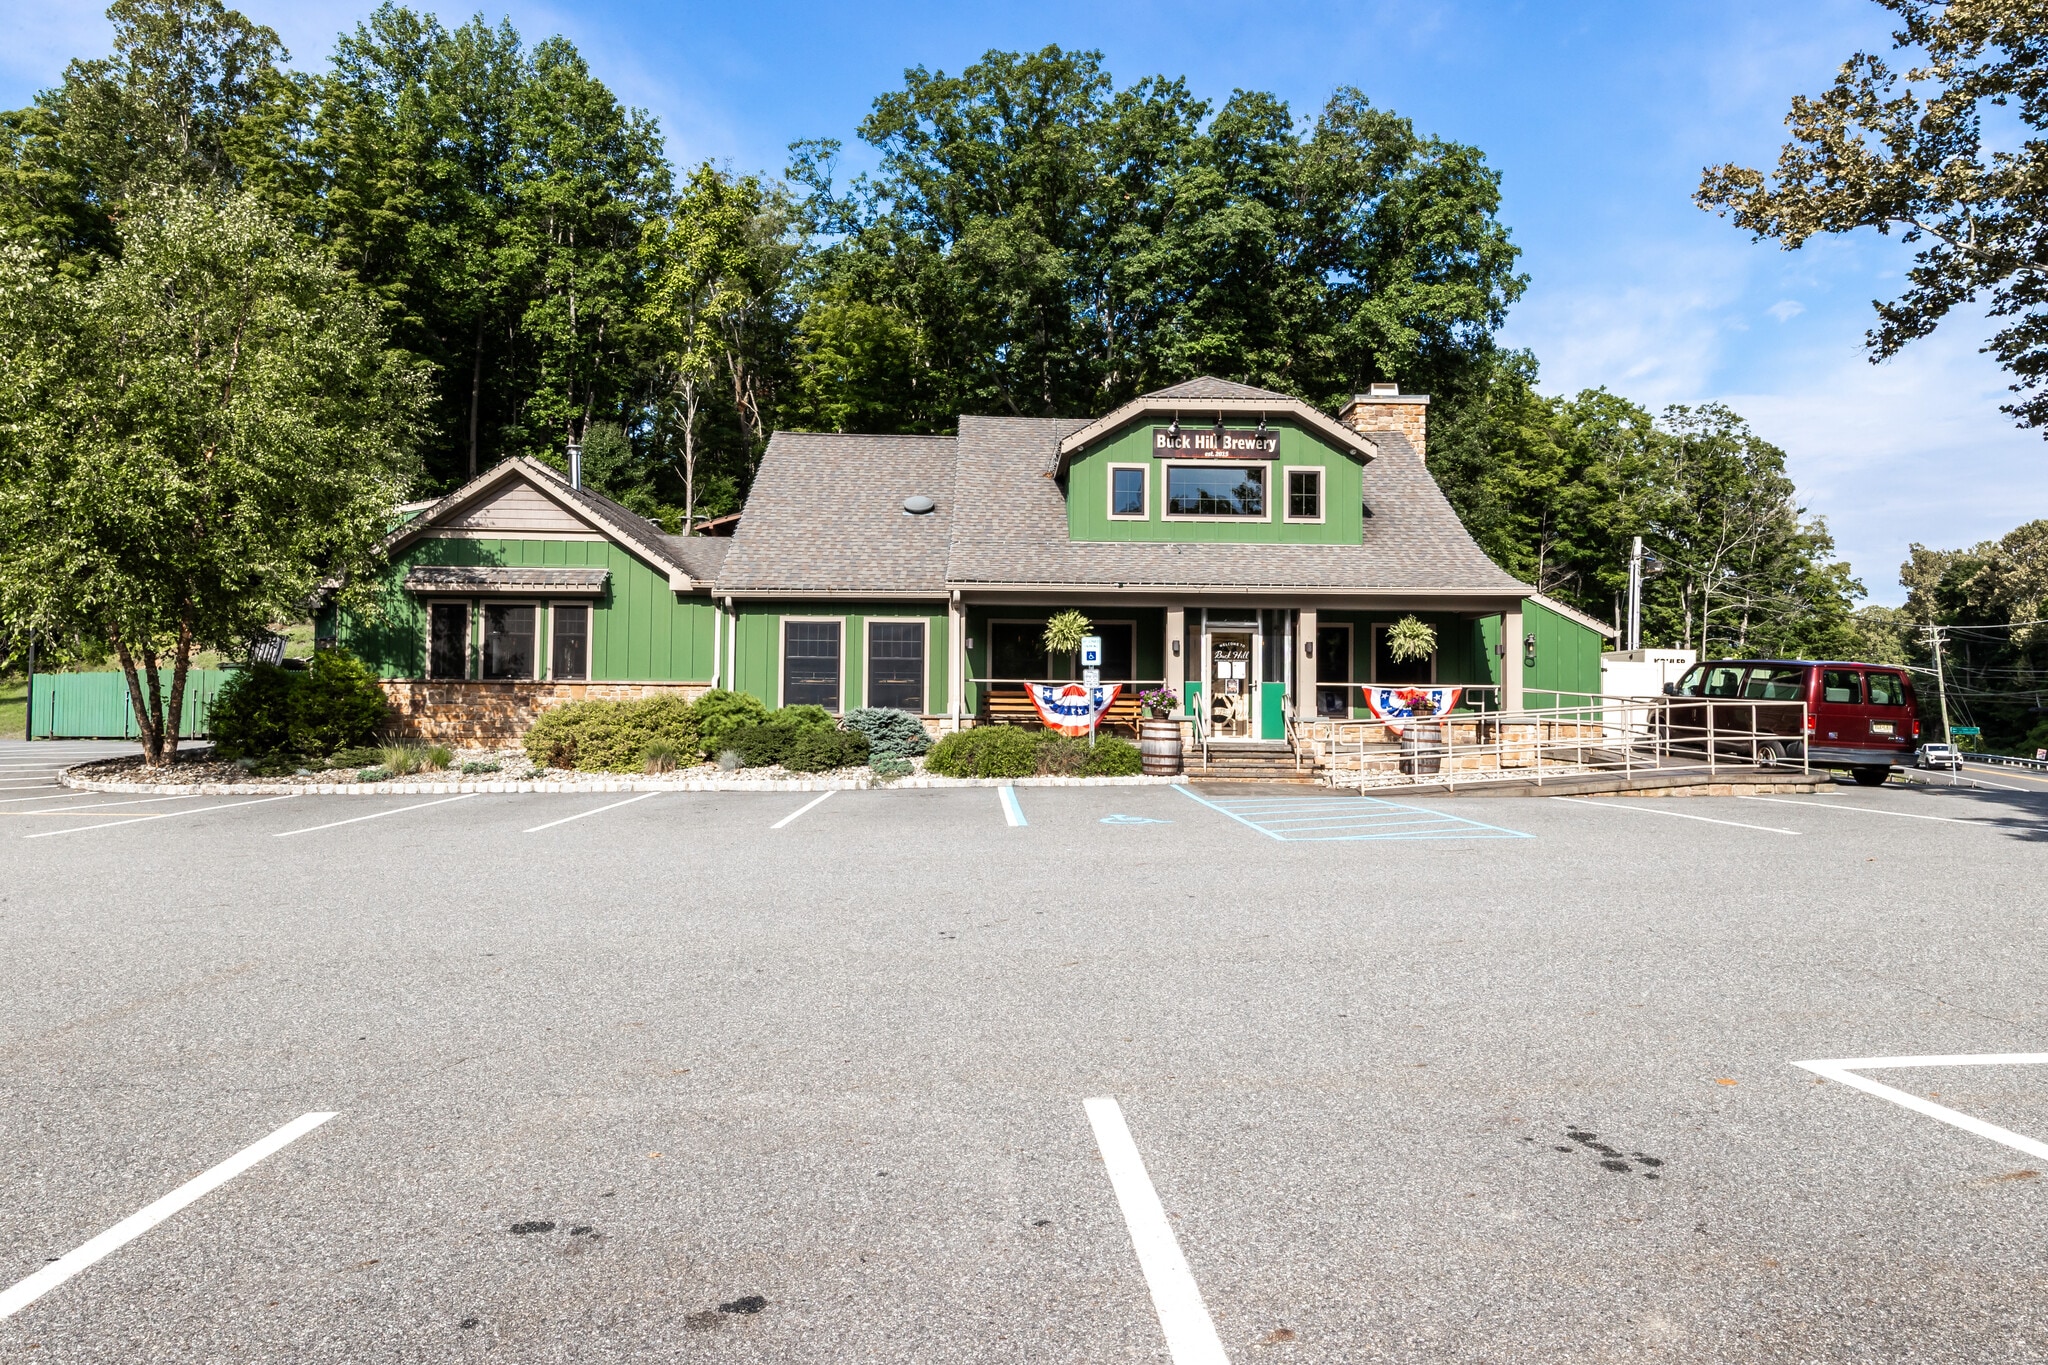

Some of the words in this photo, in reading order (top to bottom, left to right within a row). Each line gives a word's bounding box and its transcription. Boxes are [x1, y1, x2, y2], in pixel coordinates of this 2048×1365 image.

[1156, 434, 1191, 449] Buck
[1195, 434, 1218, 449] Hill
[1223, 436, 1277, 452] Brewery
